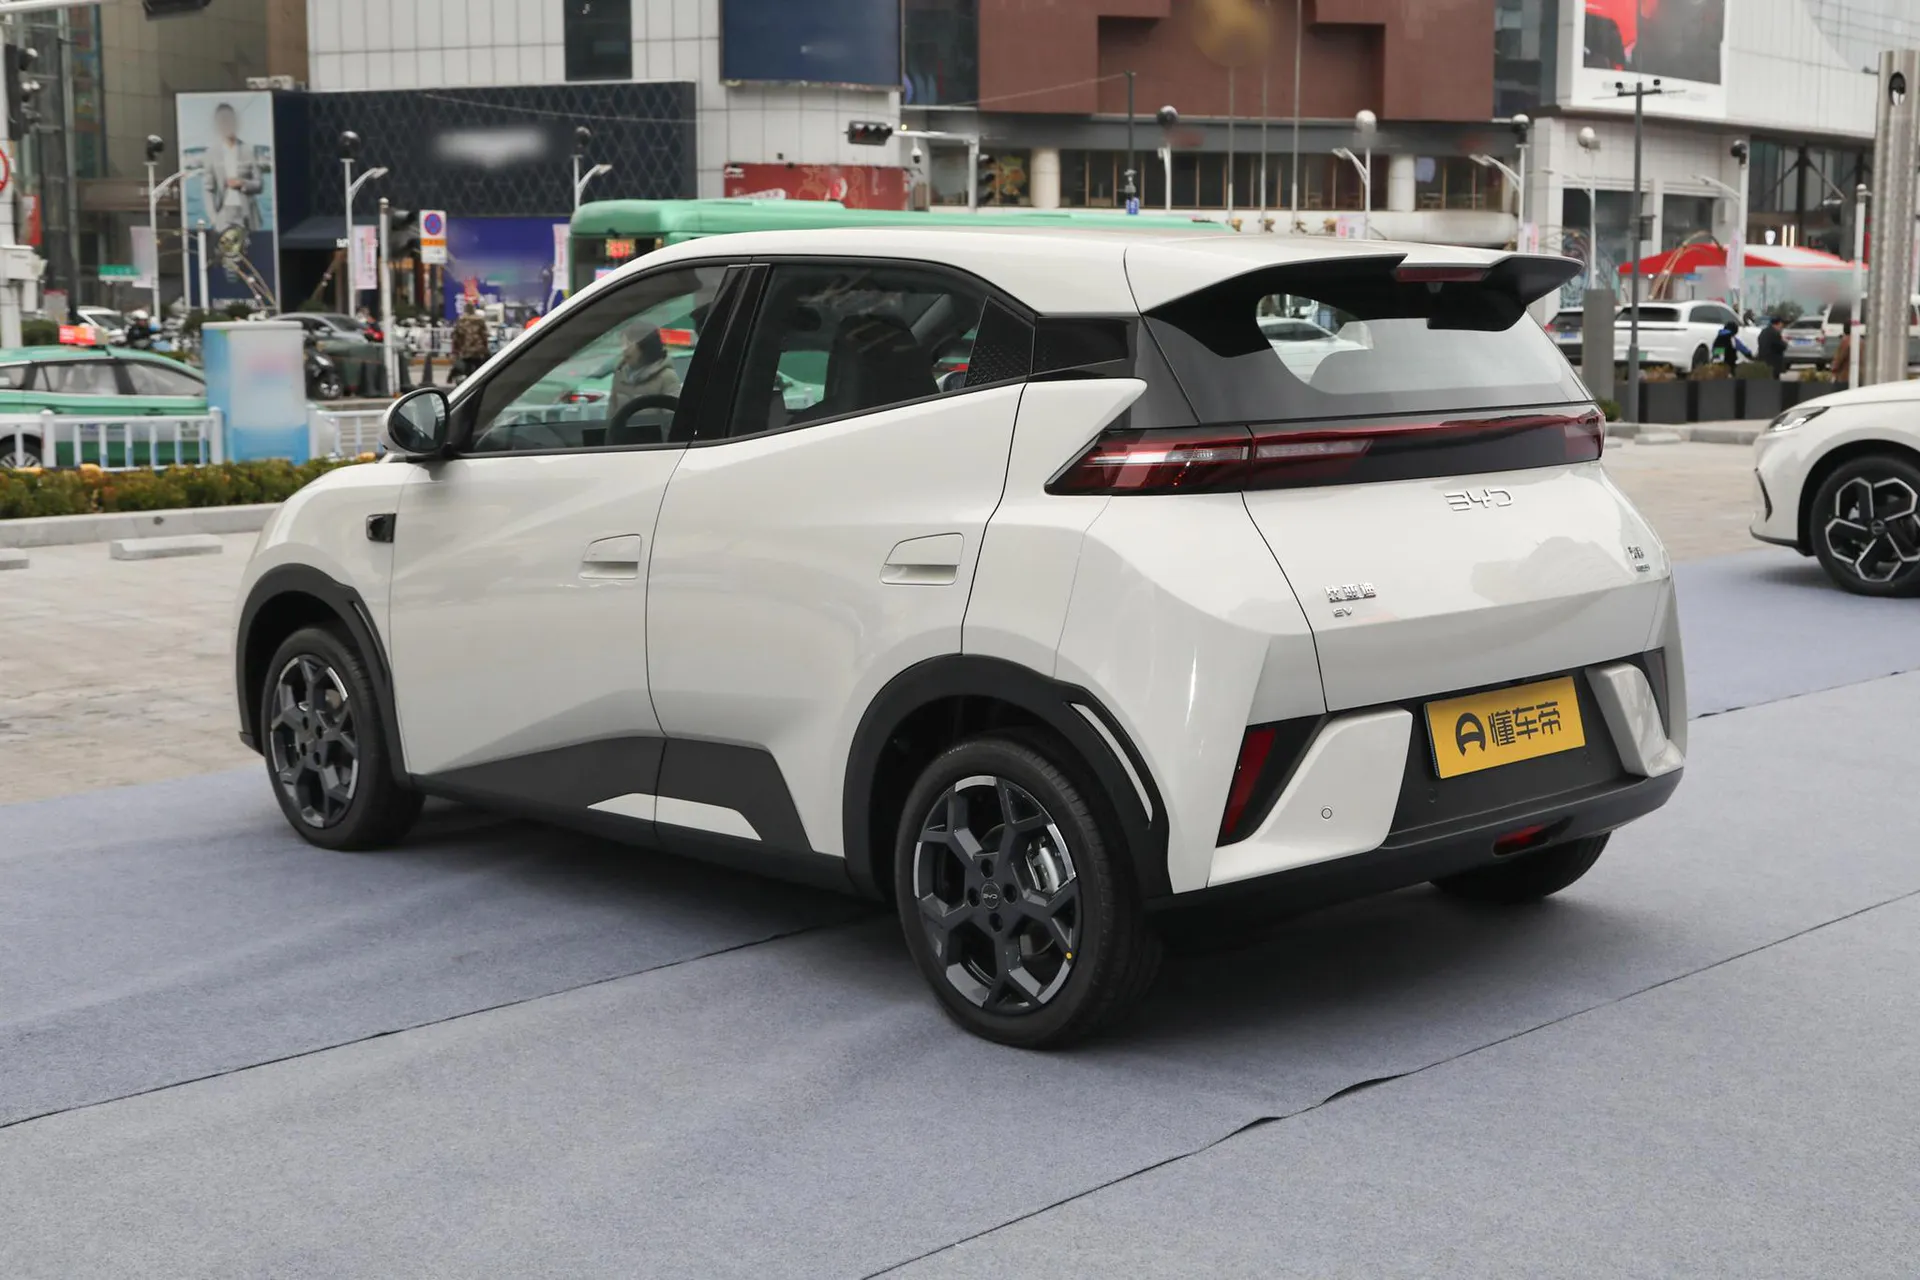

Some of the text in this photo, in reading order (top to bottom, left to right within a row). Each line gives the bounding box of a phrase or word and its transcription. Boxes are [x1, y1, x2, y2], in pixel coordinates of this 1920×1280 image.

[1332, 606, 1353, 618] EV
[1487, 701, 1561, 747] 懂车帝
